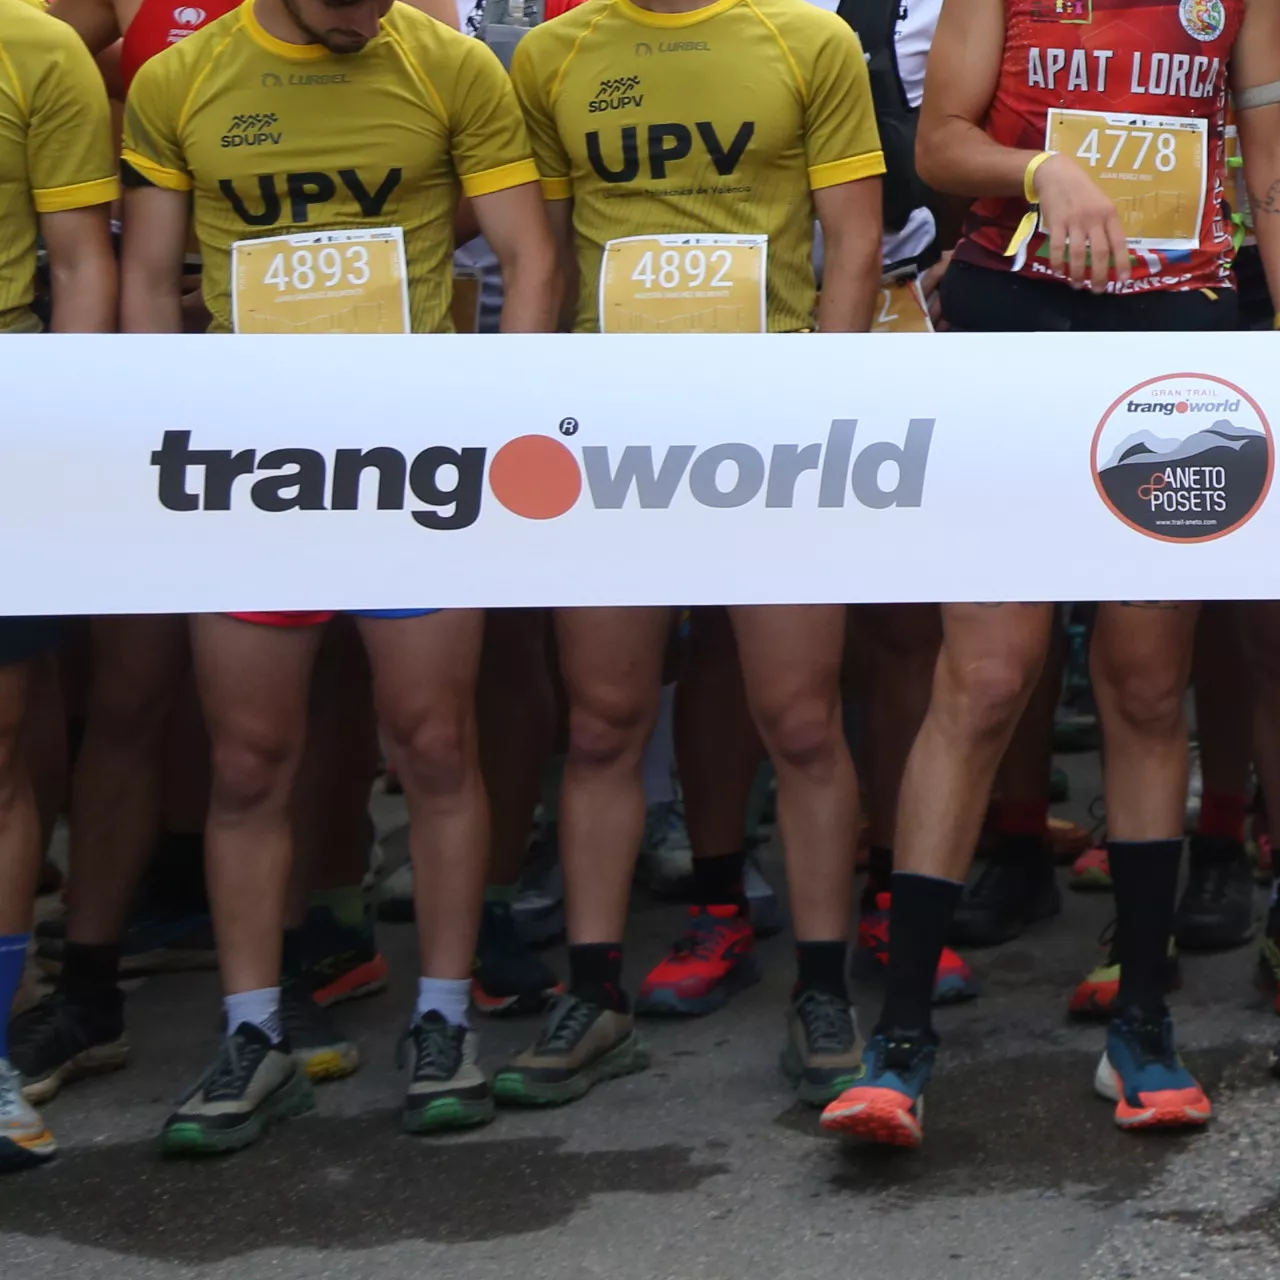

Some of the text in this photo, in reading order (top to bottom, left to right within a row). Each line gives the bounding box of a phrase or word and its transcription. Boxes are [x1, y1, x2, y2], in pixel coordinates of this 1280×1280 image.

[1028, 46, 1220, 99] APAT LORCA
[588, 94, 644, 113] SDUPV
[220, 132, 282, 148] SDUPV
[585, 121, 755, 183] UPV
[1076, 128, 1176, 172] 4778
[218, 167, 403, 226] UPV
[263, 245, 371, 291] 4893
[631, 249, 734, 288] 4892
[1151, 389, 1218, 398] GRAN TRAIL
[1164, 466, 1226, 489] ANETO
[1151, 490, 1227, 512] POSETS
